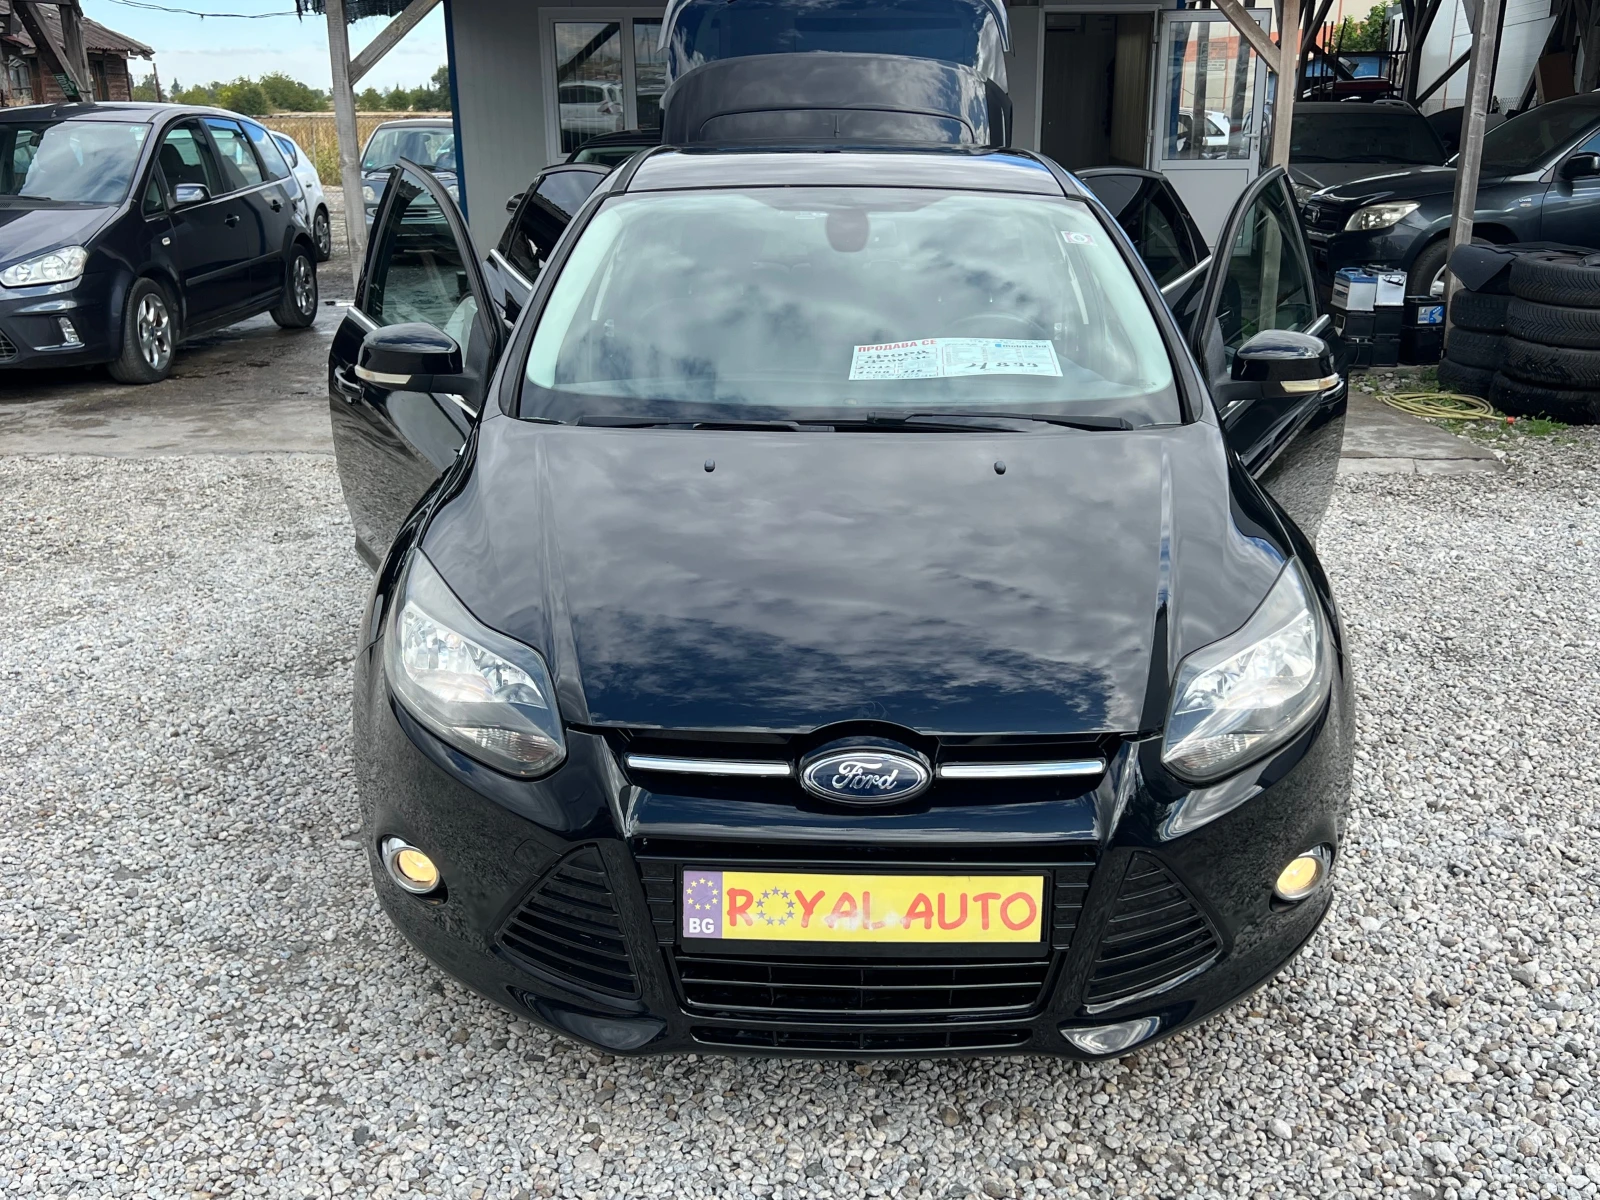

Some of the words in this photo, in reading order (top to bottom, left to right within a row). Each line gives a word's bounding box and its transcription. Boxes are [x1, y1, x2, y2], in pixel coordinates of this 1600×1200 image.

[858, 341, 917, 352] ПРОДАВА
[832, 762, 898, 789] Ford
[901, 891, 1037, 931] AUTO
[689, 917, 715, 934] BG
